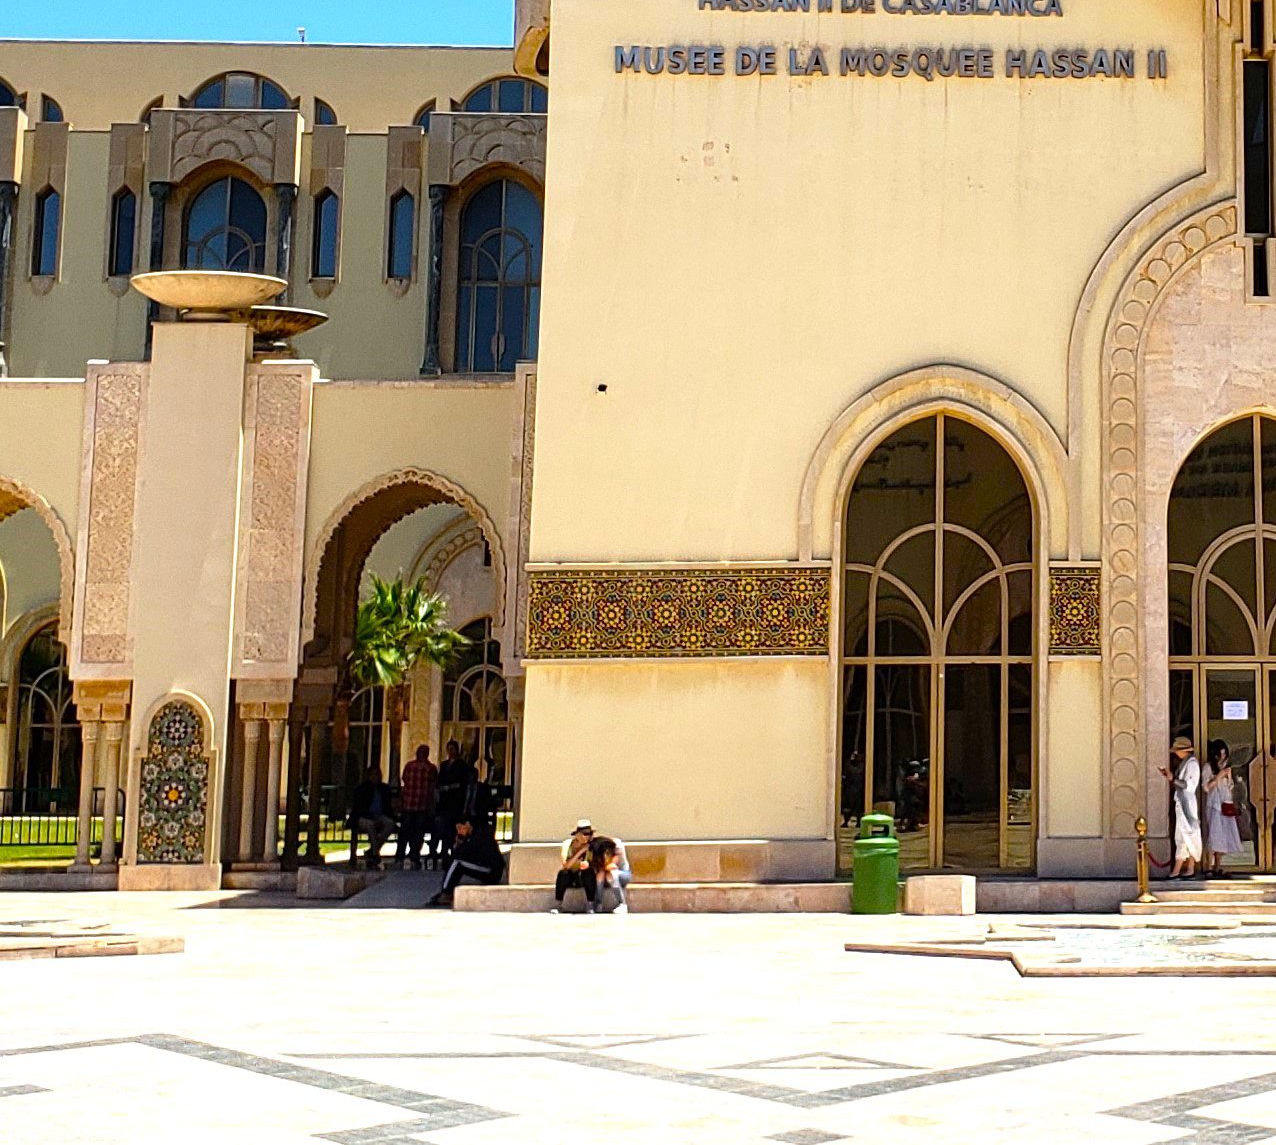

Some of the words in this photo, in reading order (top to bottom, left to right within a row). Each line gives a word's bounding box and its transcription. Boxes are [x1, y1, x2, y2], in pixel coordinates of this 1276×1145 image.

[614, 45, 725, 75] MUSEE
[735, 46, 778, 76] DE
[788, 47, 829, 77] LA
[839, 48, 994, 81] MOSQUEE
[1005, 50, 1135, 79] HASSAN
[1148, 50, 1168, 80] II
